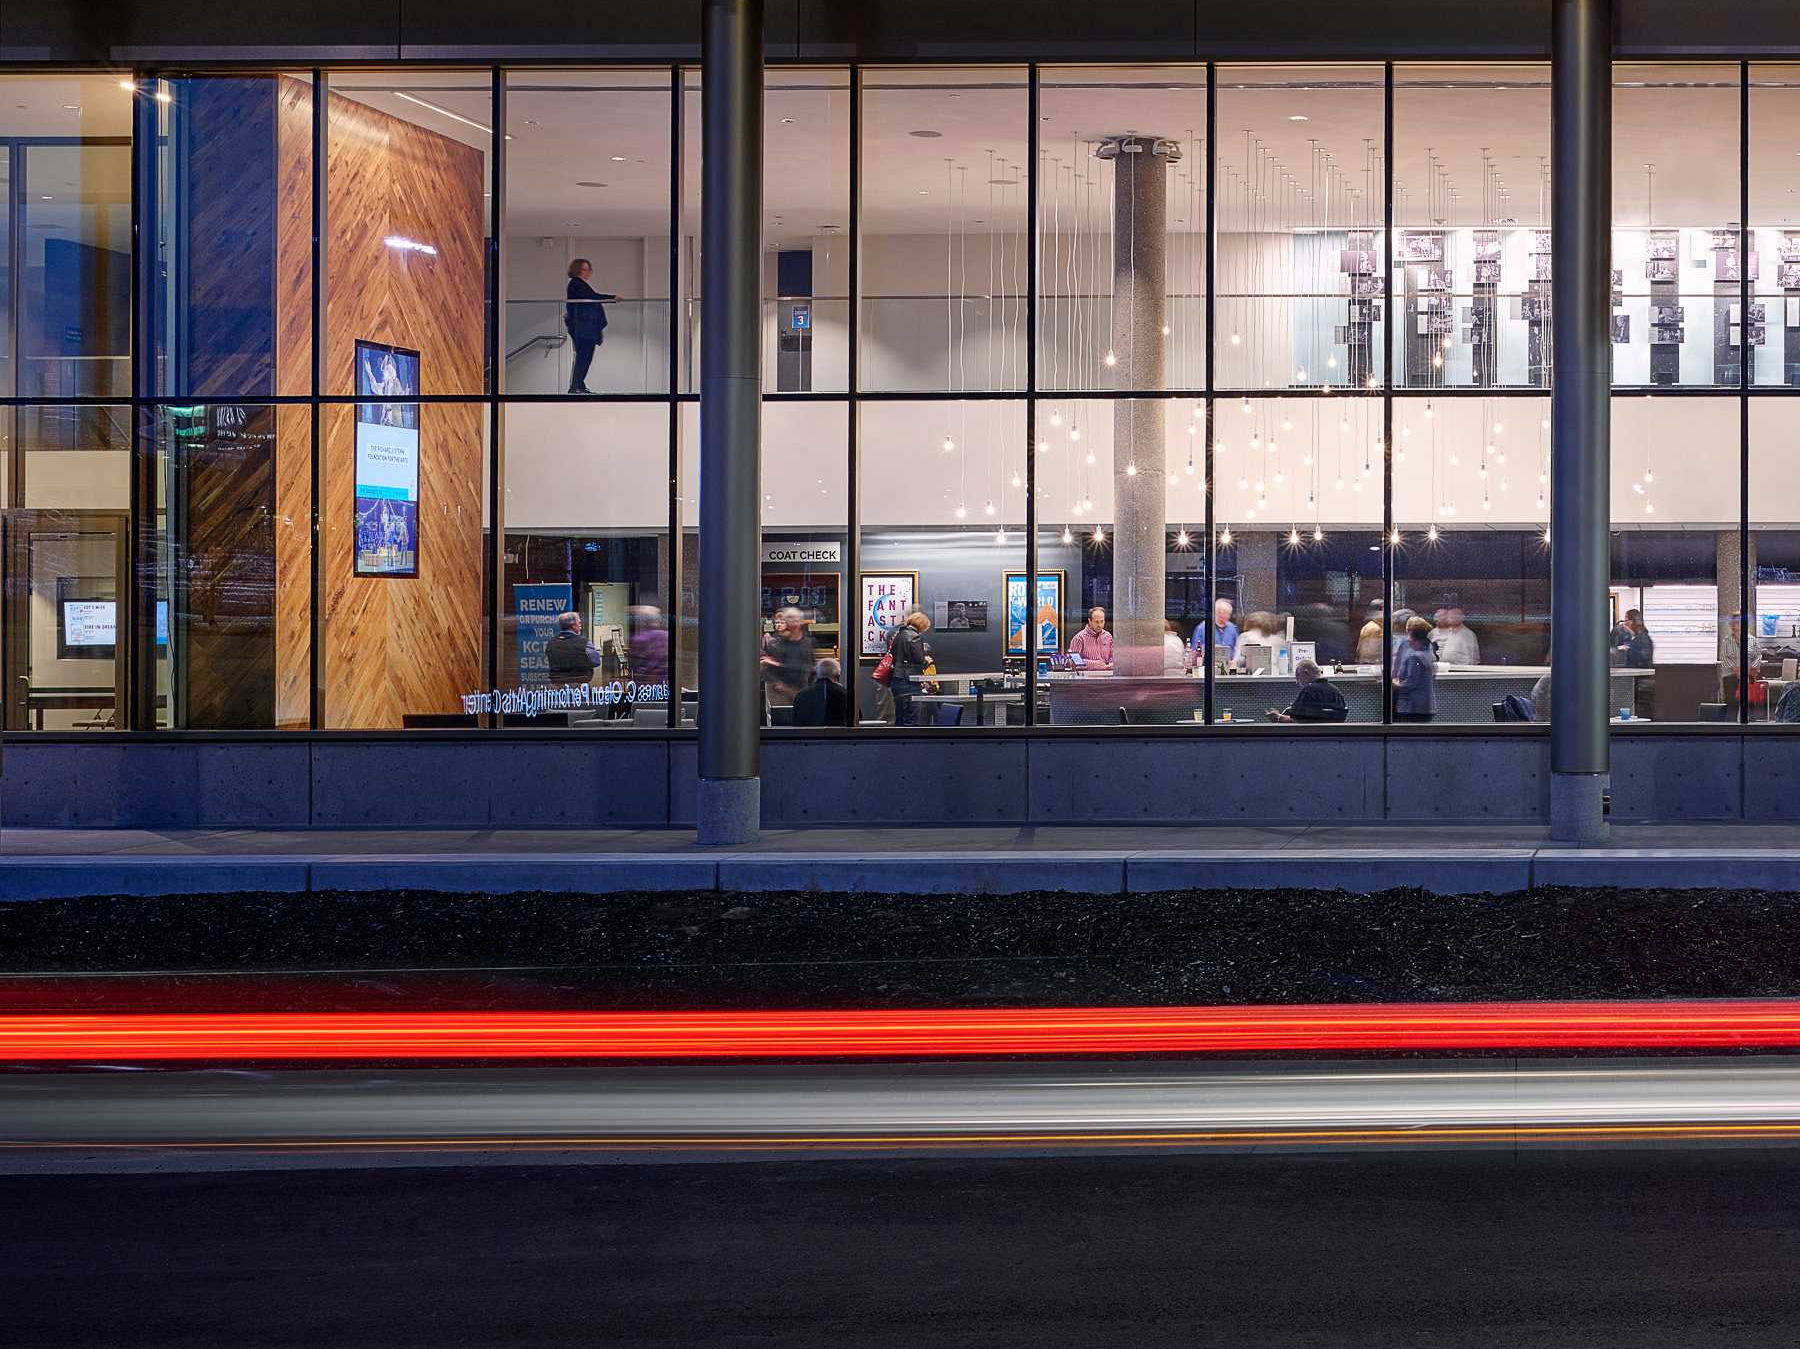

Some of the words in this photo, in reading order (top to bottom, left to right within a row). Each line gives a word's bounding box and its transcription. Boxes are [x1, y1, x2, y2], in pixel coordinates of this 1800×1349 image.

[798, 315, 804, 325] 3
[769, 551, 798, 560] COAT
[800, 551, 836, 560] CHECK
[868, 585, 896, 596] THE
[521, 599, 567, 611] RENEW
[868, 600, 906, 611] FANT
[520, 615, 530, 624] OR
[530, 615, 560, 624] PURCHA
[534, 628, 554, 637] YOUR
[523, 641, 540, 653] KC
[520, 657, 549, 669] SEAS
